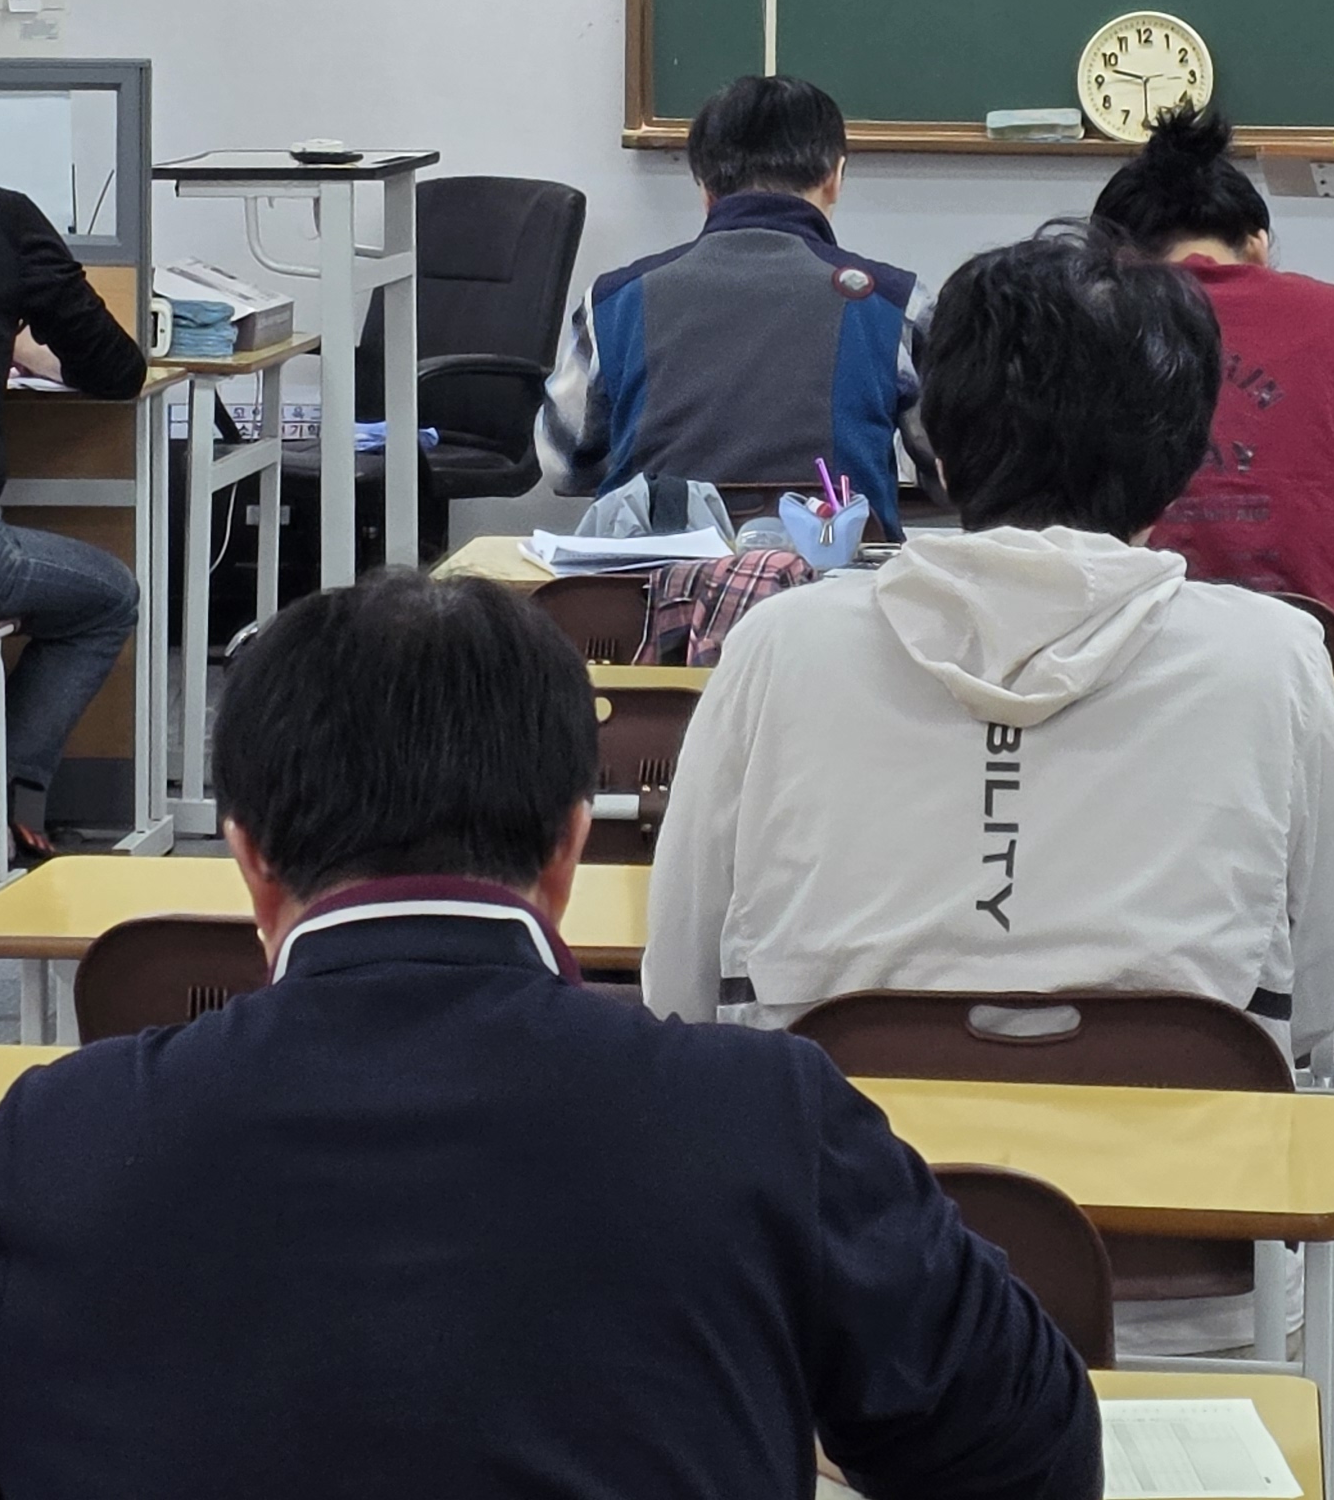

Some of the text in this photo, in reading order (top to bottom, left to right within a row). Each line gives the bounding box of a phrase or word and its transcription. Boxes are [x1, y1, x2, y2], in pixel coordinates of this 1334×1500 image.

[1117, 35, 1128, 52] 11
[1136, 28, 1153, 44] 12
[1164, 33, 1170, 50] 1
[1102, 52, 1118, 68] 10
[1178, 47, 1188, 64] 2
[1094, 74, 1105, 90] 9
[1187, 69, 1197, 85] 3
[1102, 94, 1111, 110] 8
[1120, 109, 1130, 125] 7
